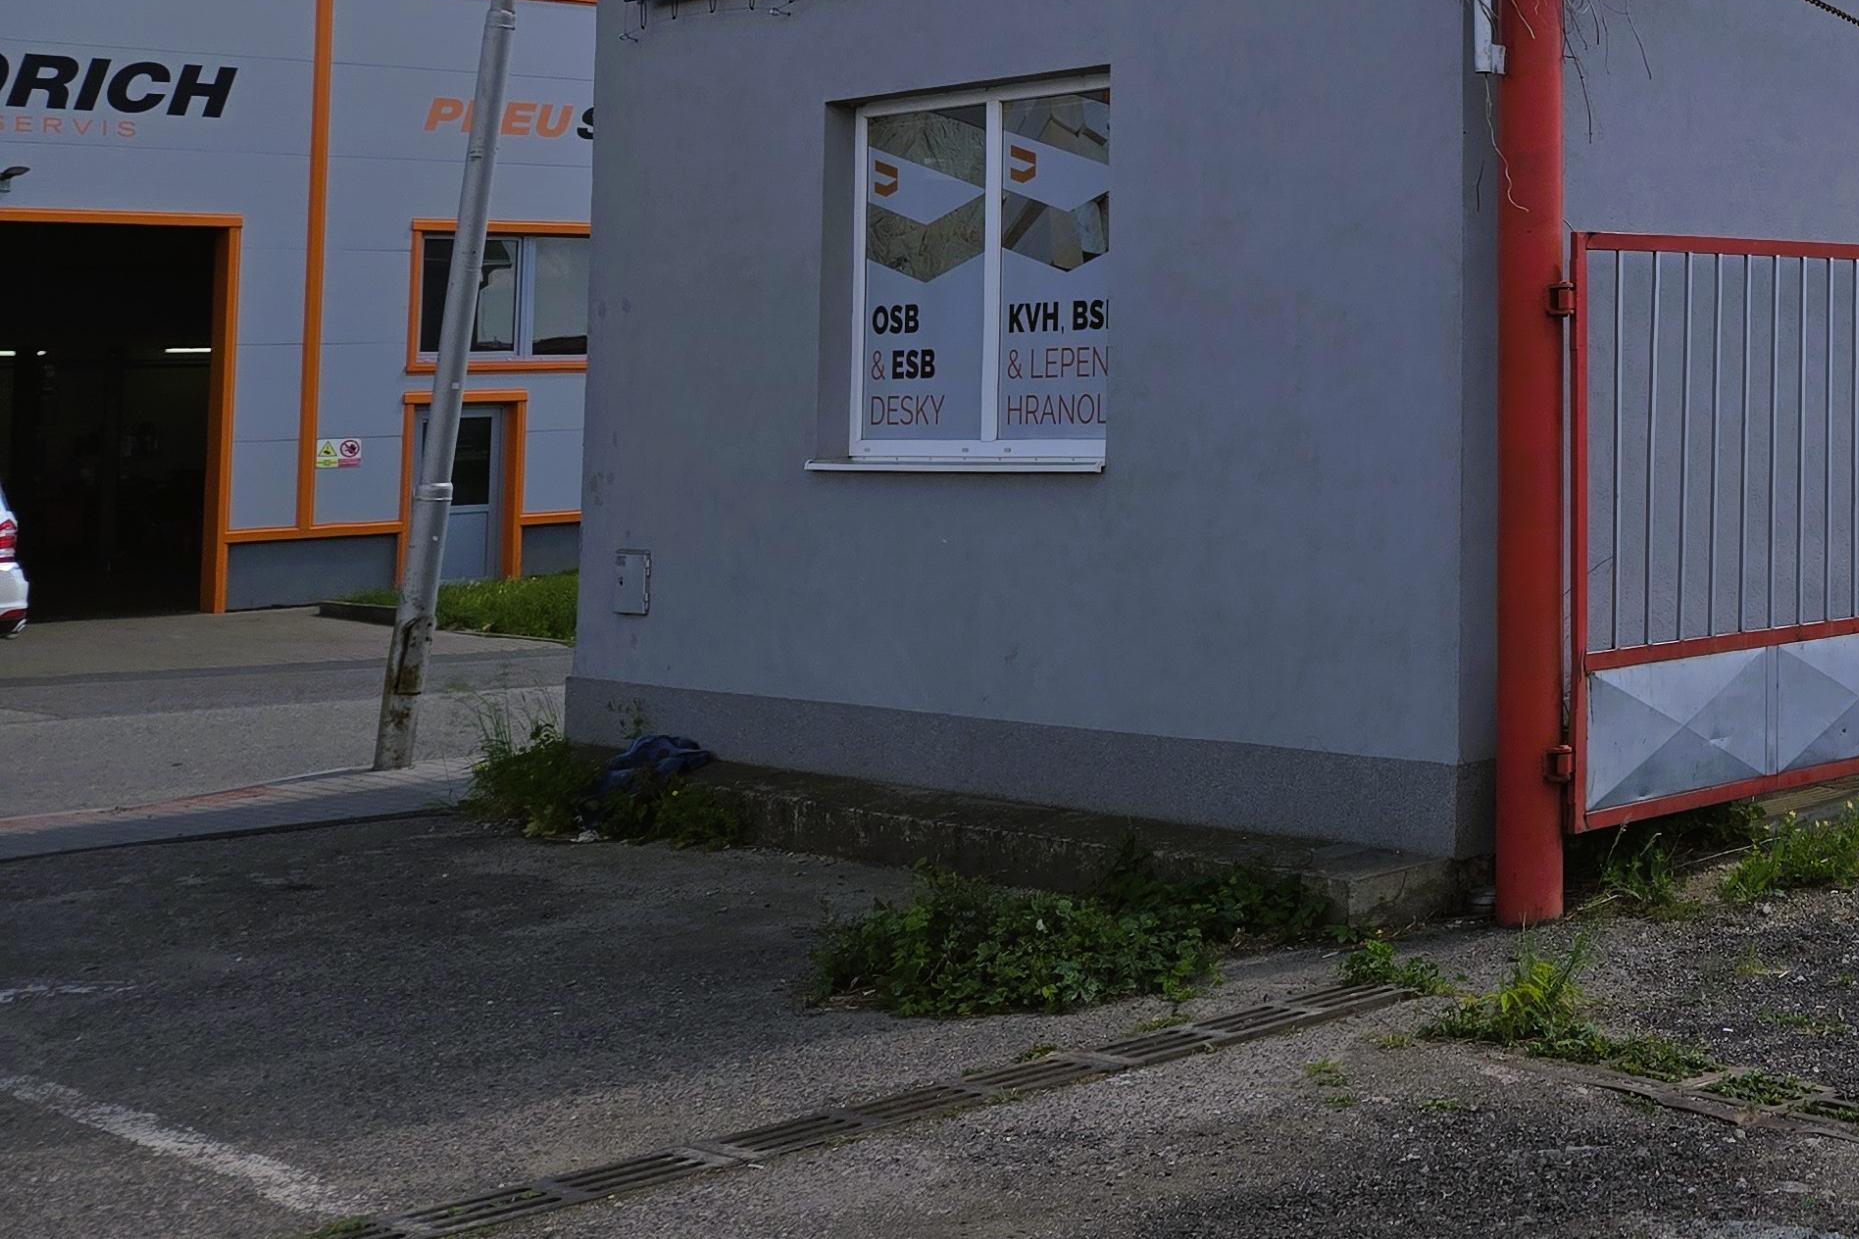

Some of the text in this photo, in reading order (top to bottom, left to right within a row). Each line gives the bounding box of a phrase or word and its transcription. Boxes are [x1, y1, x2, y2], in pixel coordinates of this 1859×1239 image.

[0, 53, 238, 118] RICH
[0, 115, 136, 138] ERVIS
[872, 304, 920, 335] OSB
[1008, 299, 1109, 334] KVH, BS
[871, 348, 936, 380] & ESB
[1007, 349, 1023, 380] &
[870, 394, 945, 425] DESKY
[1007, 393, 1107, 425] HRANOL
